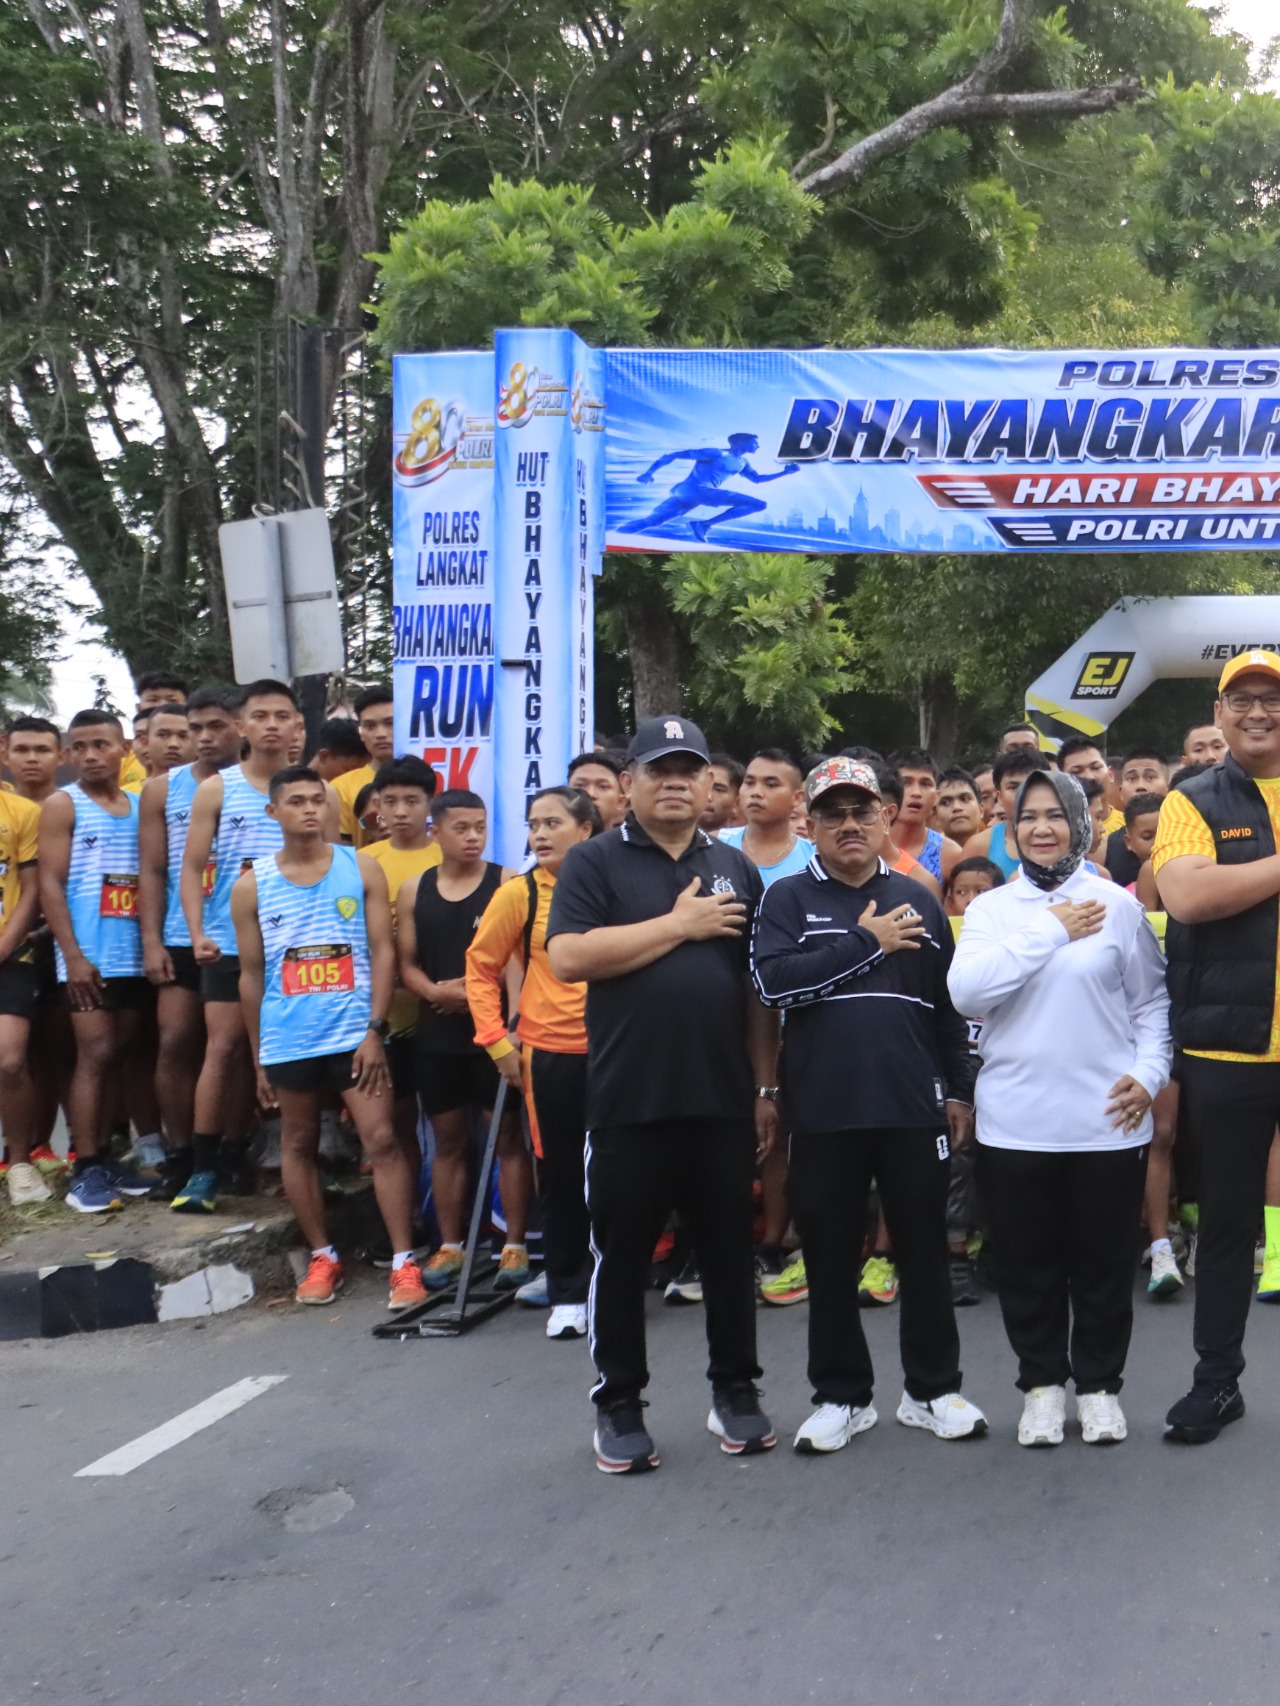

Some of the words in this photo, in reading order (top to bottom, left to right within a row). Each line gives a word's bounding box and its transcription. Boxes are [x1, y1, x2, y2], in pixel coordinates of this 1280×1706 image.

[1058, 359, 1280, 388] POLRES
[516, 451, 549, 483] HUT
[1012, 477, 1138, 504] HARI
[422, 510, 481, 545] POLRES
[1066, 518, 1189, 542] POLRI
[416, 550, 488, 587] LANGKAT
[393, 602, 494, 659] BHAYANGKA
[578, 498, 588, 756] BHAYANGK
[524, 490, 544, 857] BHAYANGKA
[1080, 657, 1130, 686] EJ
[409, 664, 494, 739] RUN
[1076, 686, 1118, 696] SPORT
[421, 747, 480, 797] 5K
[1220, 827, 1253, 839] DAVID
[296, 962, 341, 987] 105
